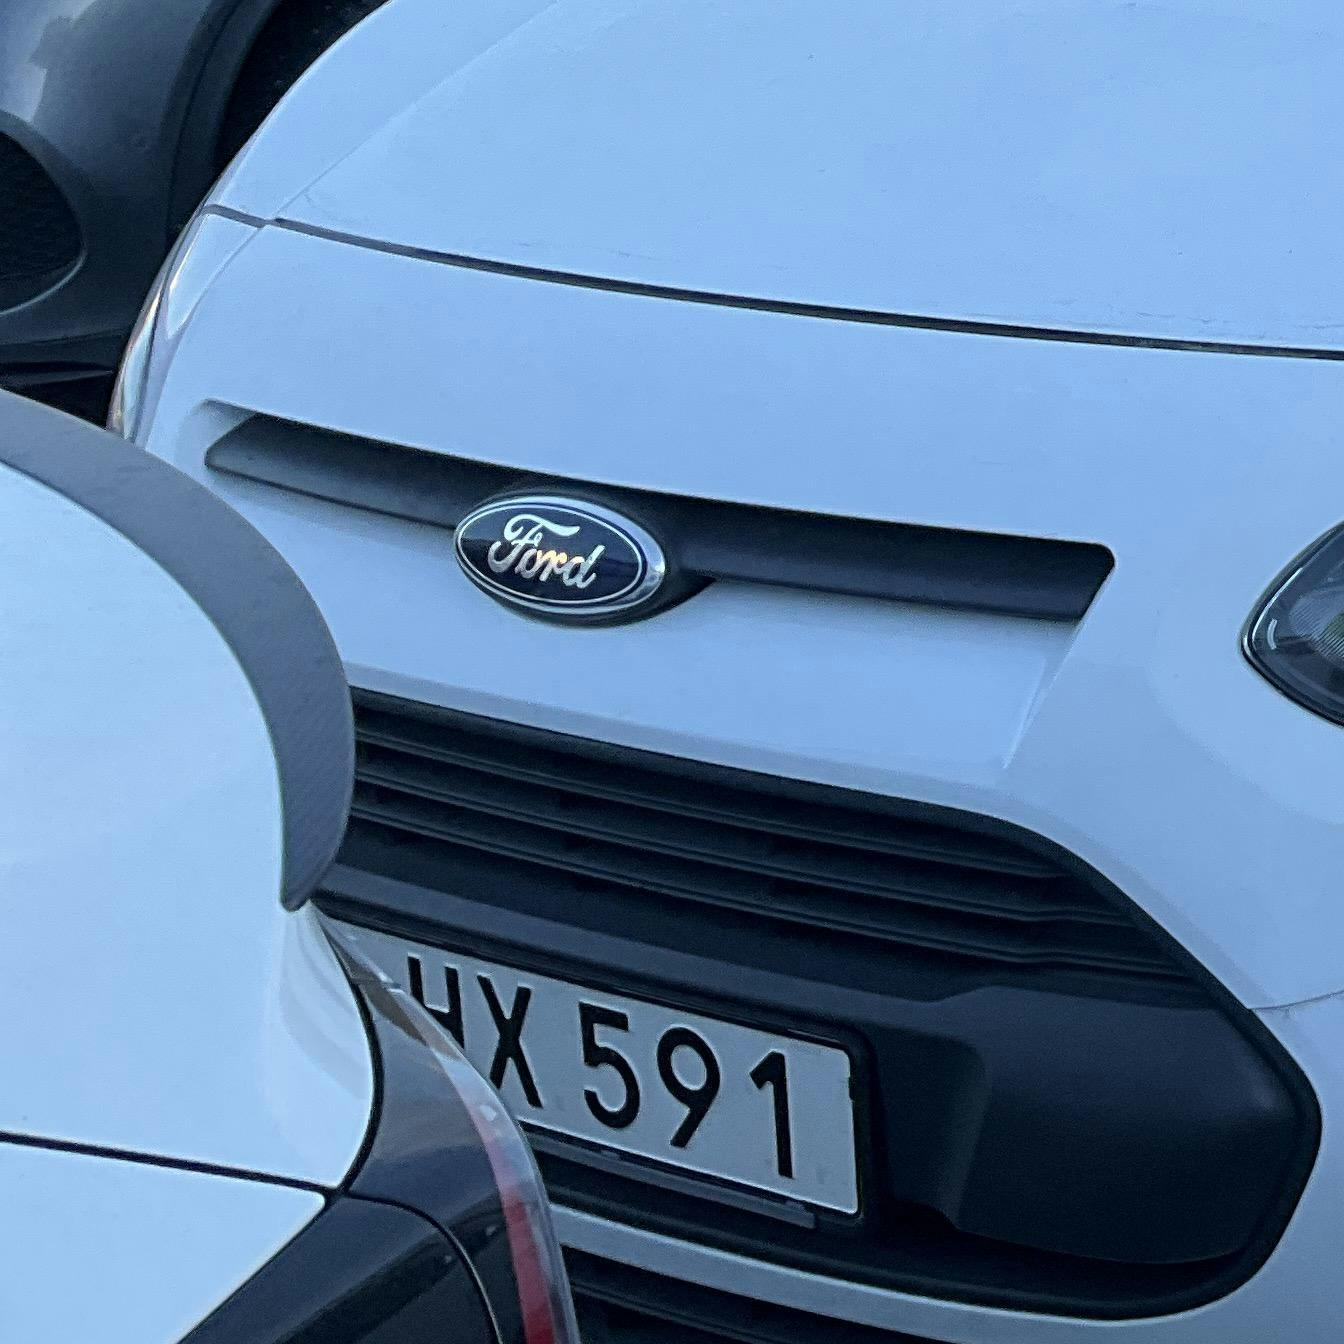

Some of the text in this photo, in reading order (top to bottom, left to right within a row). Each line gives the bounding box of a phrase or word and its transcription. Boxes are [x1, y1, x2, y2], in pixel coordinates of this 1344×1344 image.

[487, 513, 605, 589] Ford
[406, 955, 795, 1179] HX 591
